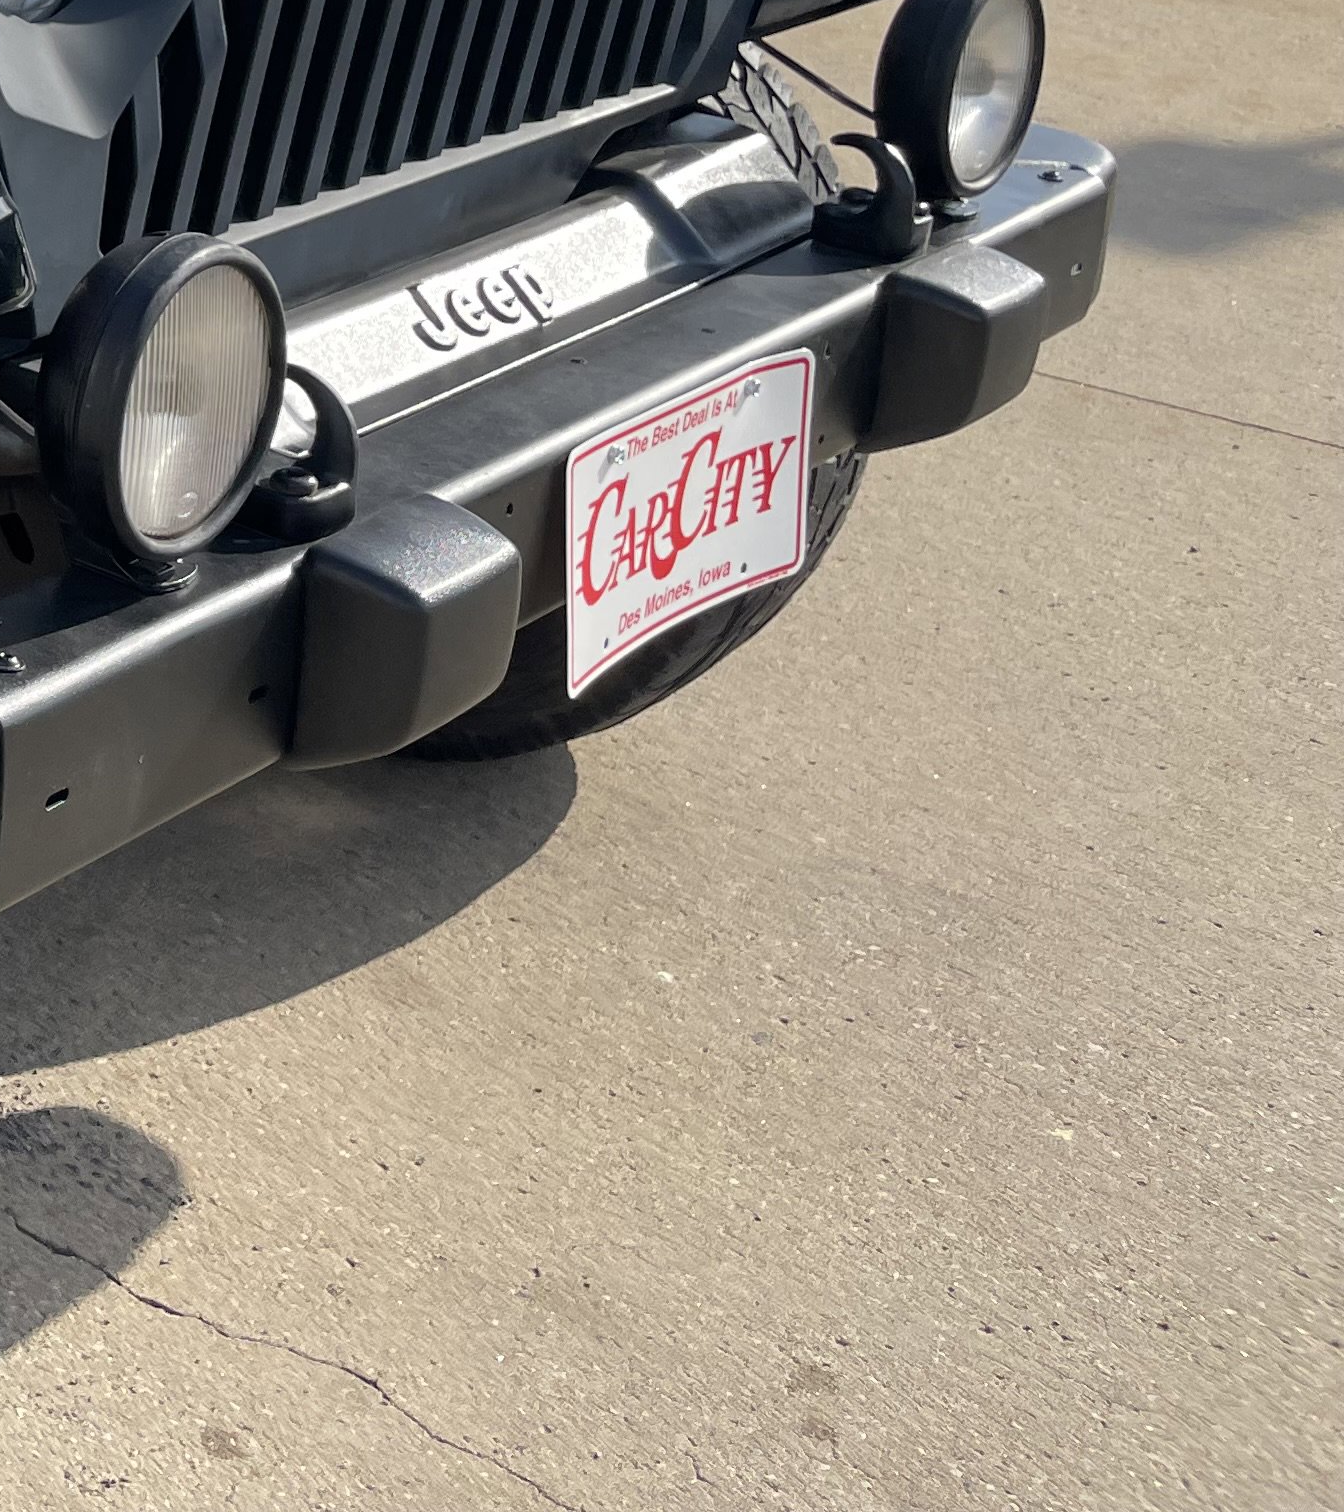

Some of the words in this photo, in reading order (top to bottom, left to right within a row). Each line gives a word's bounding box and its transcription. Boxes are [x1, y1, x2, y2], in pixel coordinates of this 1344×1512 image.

[407, 265, 554, 352] Jeep
[627, 437, 648, 457] The
[652, 418, 679, 447] Best
[682, 402, 710, 432] Deal
[711, 398, 722, 418] Is
[724, 390, 737, 412] At
[618, 607, 640, 636] Des
[644, 579, 694, 618] Moines,
[699, 561, 731, 588] Iowa
